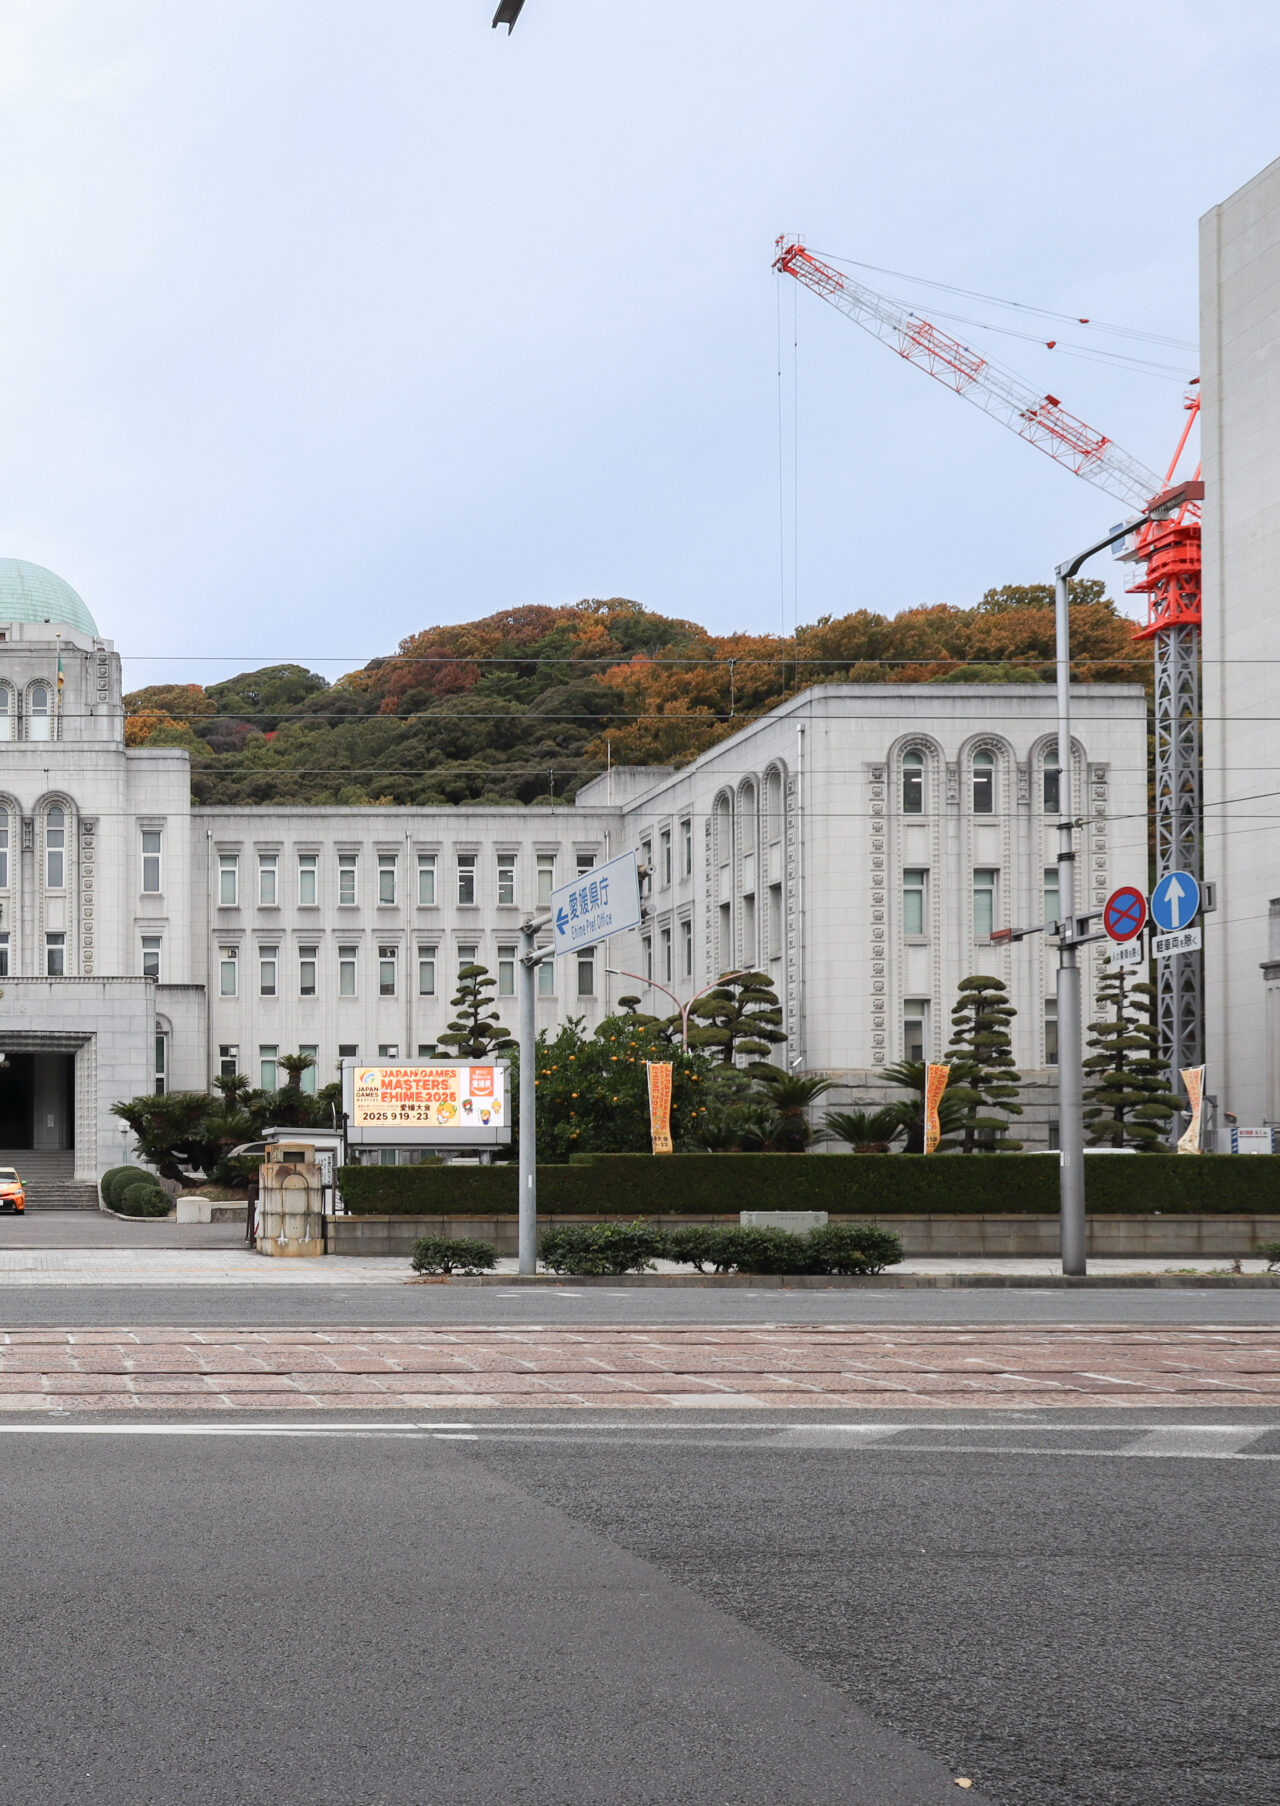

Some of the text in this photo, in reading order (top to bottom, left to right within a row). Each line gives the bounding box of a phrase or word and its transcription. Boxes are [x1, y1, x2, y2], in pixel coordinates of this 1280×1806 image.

[569, 876, 609, 920] 愛媛県庁
[571, 924, 586, 940] Ehime
[597, 912, 613, 929] Office
[1156, 934, 1198, 953] 軽車両を除く
[382, 1069, 457, 1078] JAPAN GAMES
[381, 1079, 449, 1091] MASTERS
[363, 1112, 388, 1120] 2025
